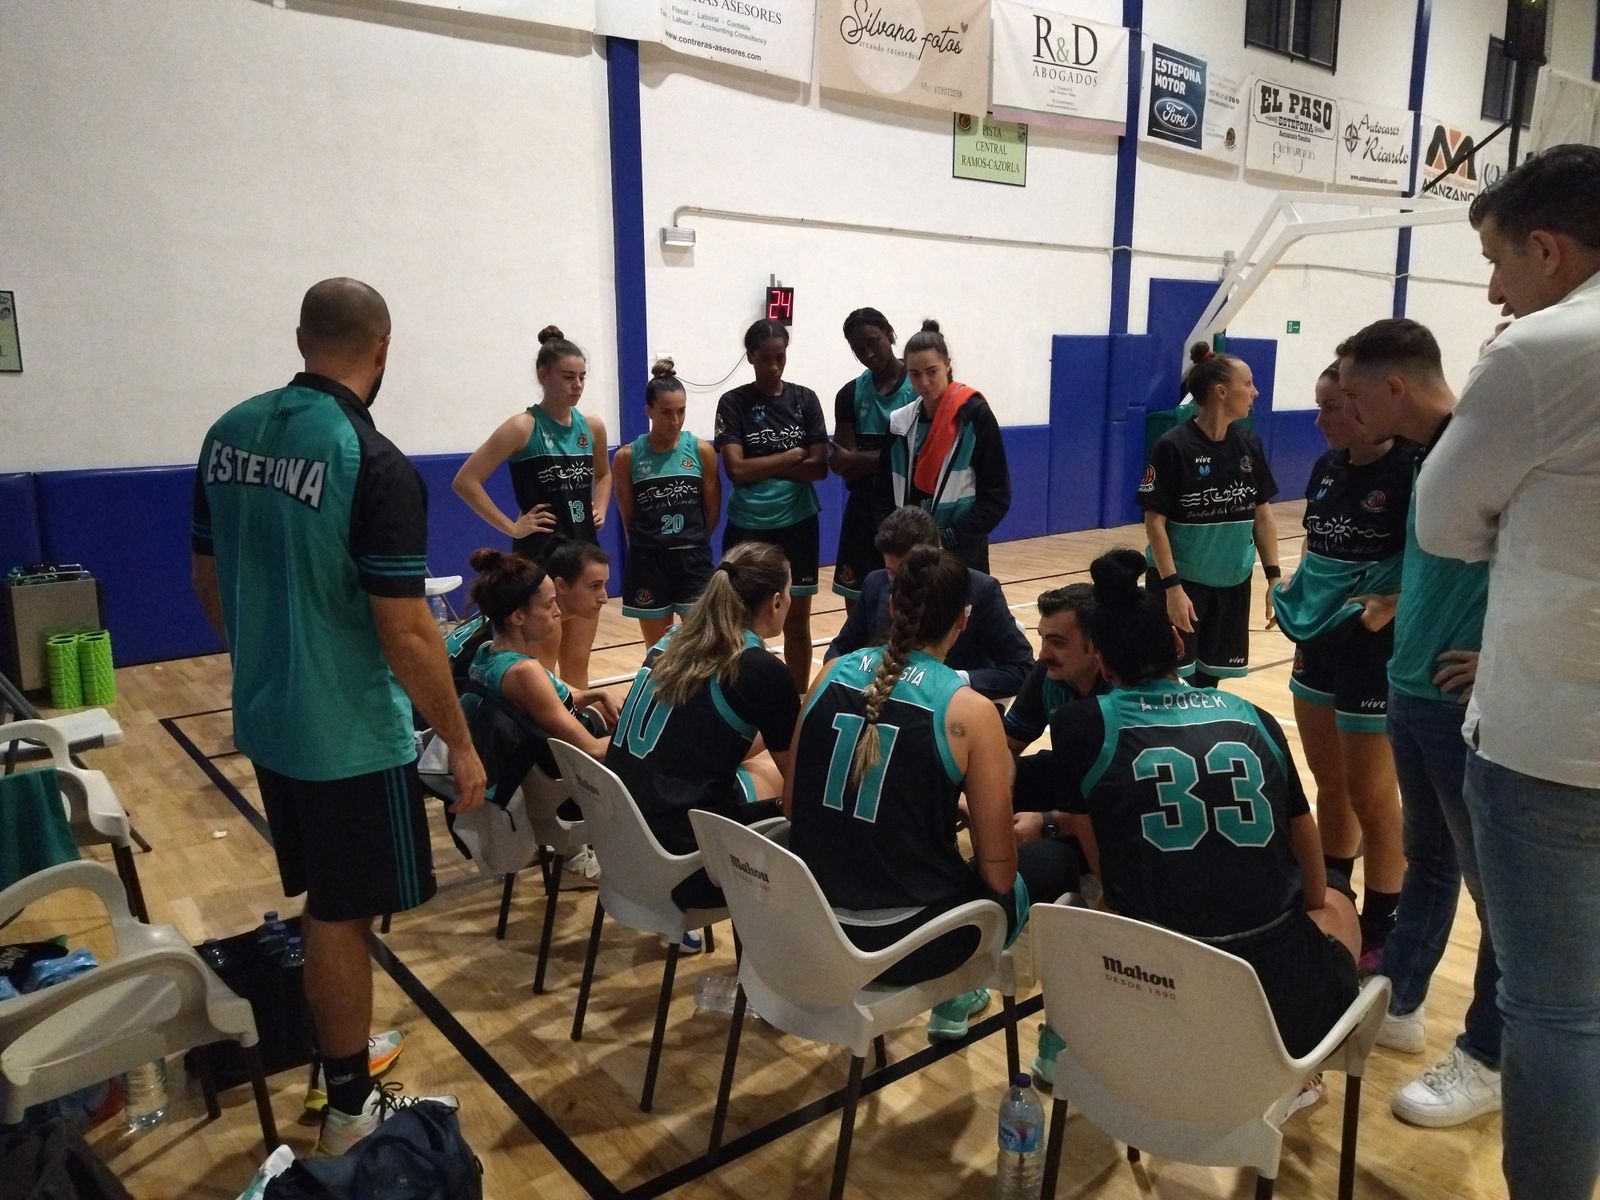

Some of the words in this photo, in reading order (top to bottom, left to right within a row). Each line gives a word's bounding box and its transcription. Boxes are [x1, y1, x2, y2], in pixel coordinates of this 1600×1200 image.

[672, 6, 689, 15] Fiscal
[697, 13, 719, 23] Laboral
[727, 20, 751, 31] Contable
[721, 0, 782, 24] ASESORES
[840, 0, 917, 44] Silvana
[673, 16, 692, 26] Labour
[701, 23, 734, 37] Accounting
[734, 31, 767, 46] Consultancy
[1033, 14, 1098, 66] R&D
[665, 30, 762, 61] www.contreras-asesores.com
[1033, 65, 1098, 87] ABOGADOS
[1155, 57, 1201, 84] ESTEPONA
[1155, 73, 1186, 95] MOTOR
[1162, 102, 1189, 127] Ford
[1261, 85, 1283, 114] EL
[1289, 93, 1332, 130] PASO
[982, 125, 1002, 138] PISTA
[1278, 116, 1314, 133] ESTEPONA
[1358, 113, 1400, 135] Autocares
[975, 140, 1008, 155] CENTRAL
[1363, 136, 1409, 164] Ricardo
[961, 154, 1020, 173] RAMOS-CAZORLA
[769, 290, 791, 319] 24
[207, 440, 327, 510] ESTEPONA
[568, 500, 586, 523] 13
[661, 514, 684, 534] 20
[858, 655, 872, 672] N.
[613, 666, 674, 759] 10
[1360, 698, 1386, 709] vive
[823, 712, 899, 824] 11
[1132, 741, 1275, 852] 33
[1102, 955, 1176, 990] Mahou
[1105, 973, 1142, 991] DESDE
